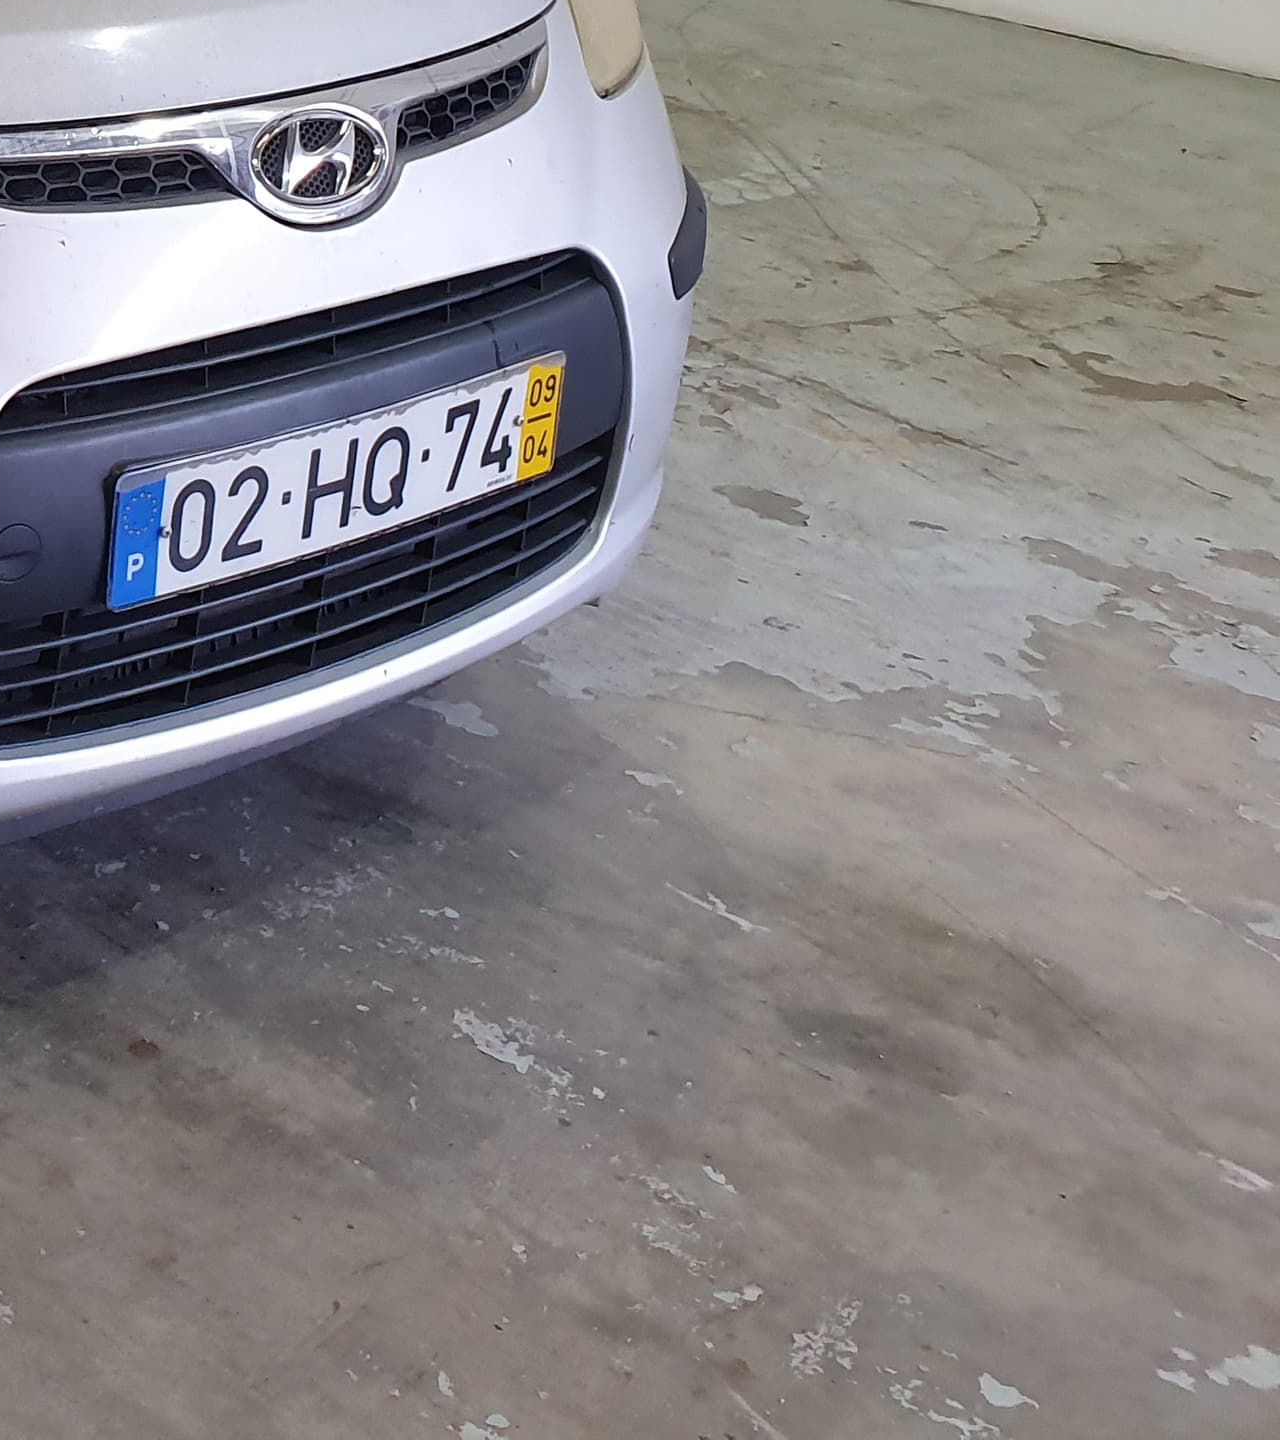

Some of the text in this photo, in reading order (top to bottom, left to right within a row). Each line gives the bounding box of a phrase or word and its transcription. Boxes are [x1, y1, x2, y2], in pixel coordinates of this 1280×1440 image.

[530, 374, 557, 408] 09
[523, 429, 548, 464] 04
[126, 553, 144, 581] P
